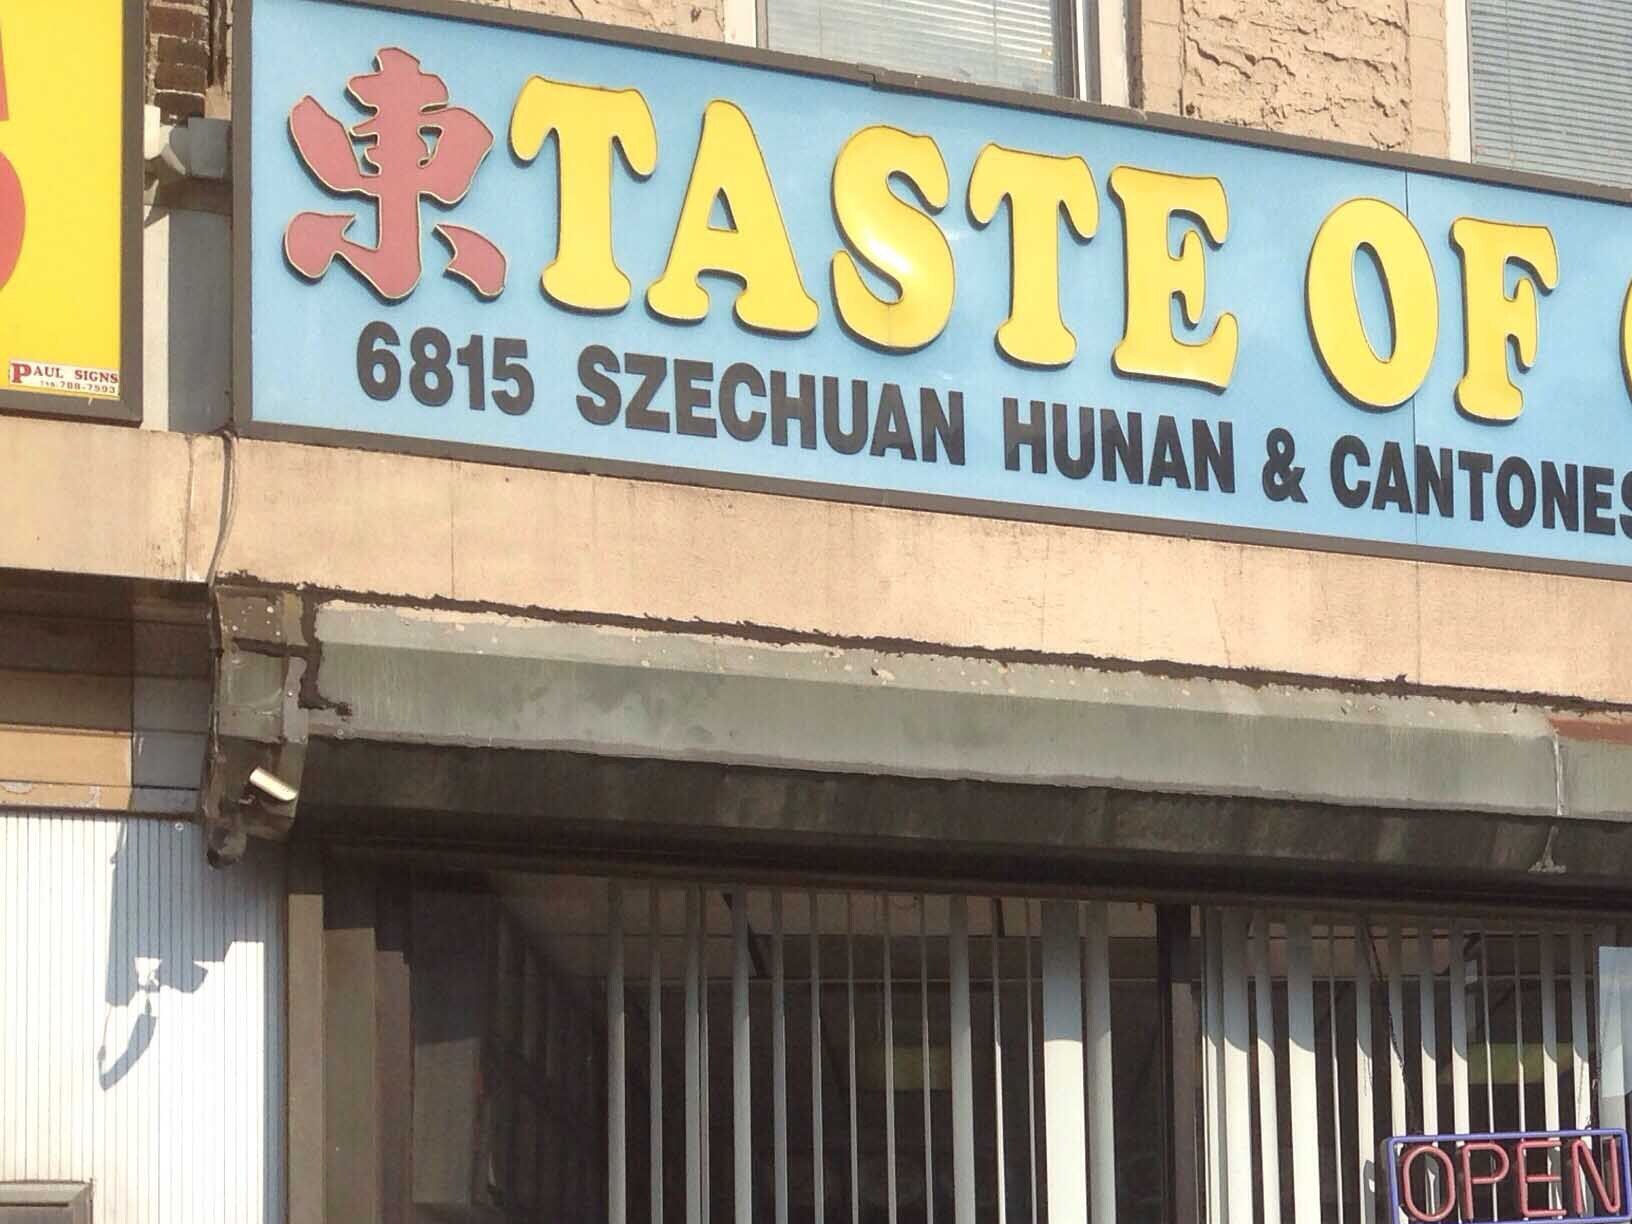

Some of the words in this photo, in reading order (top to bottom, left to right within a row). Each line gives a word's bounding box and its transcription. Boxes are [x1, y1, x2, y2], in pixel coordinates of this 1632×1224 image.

[510, 75, 1238, 386] TASTE
[1306, 196, 1560, 424] OF
[12, 362, 64, 383] PAUL
[74, 369, 120, 383] SIGNS
[357, 320, 534, 417] 6815
[576, 344, 966, 467] SZECHUAN
[1004, 397, 1236, 494] HUNAN
[1261, 426, 1309, 504] &
[1402, 1137, 1622, 1223] OPEN
